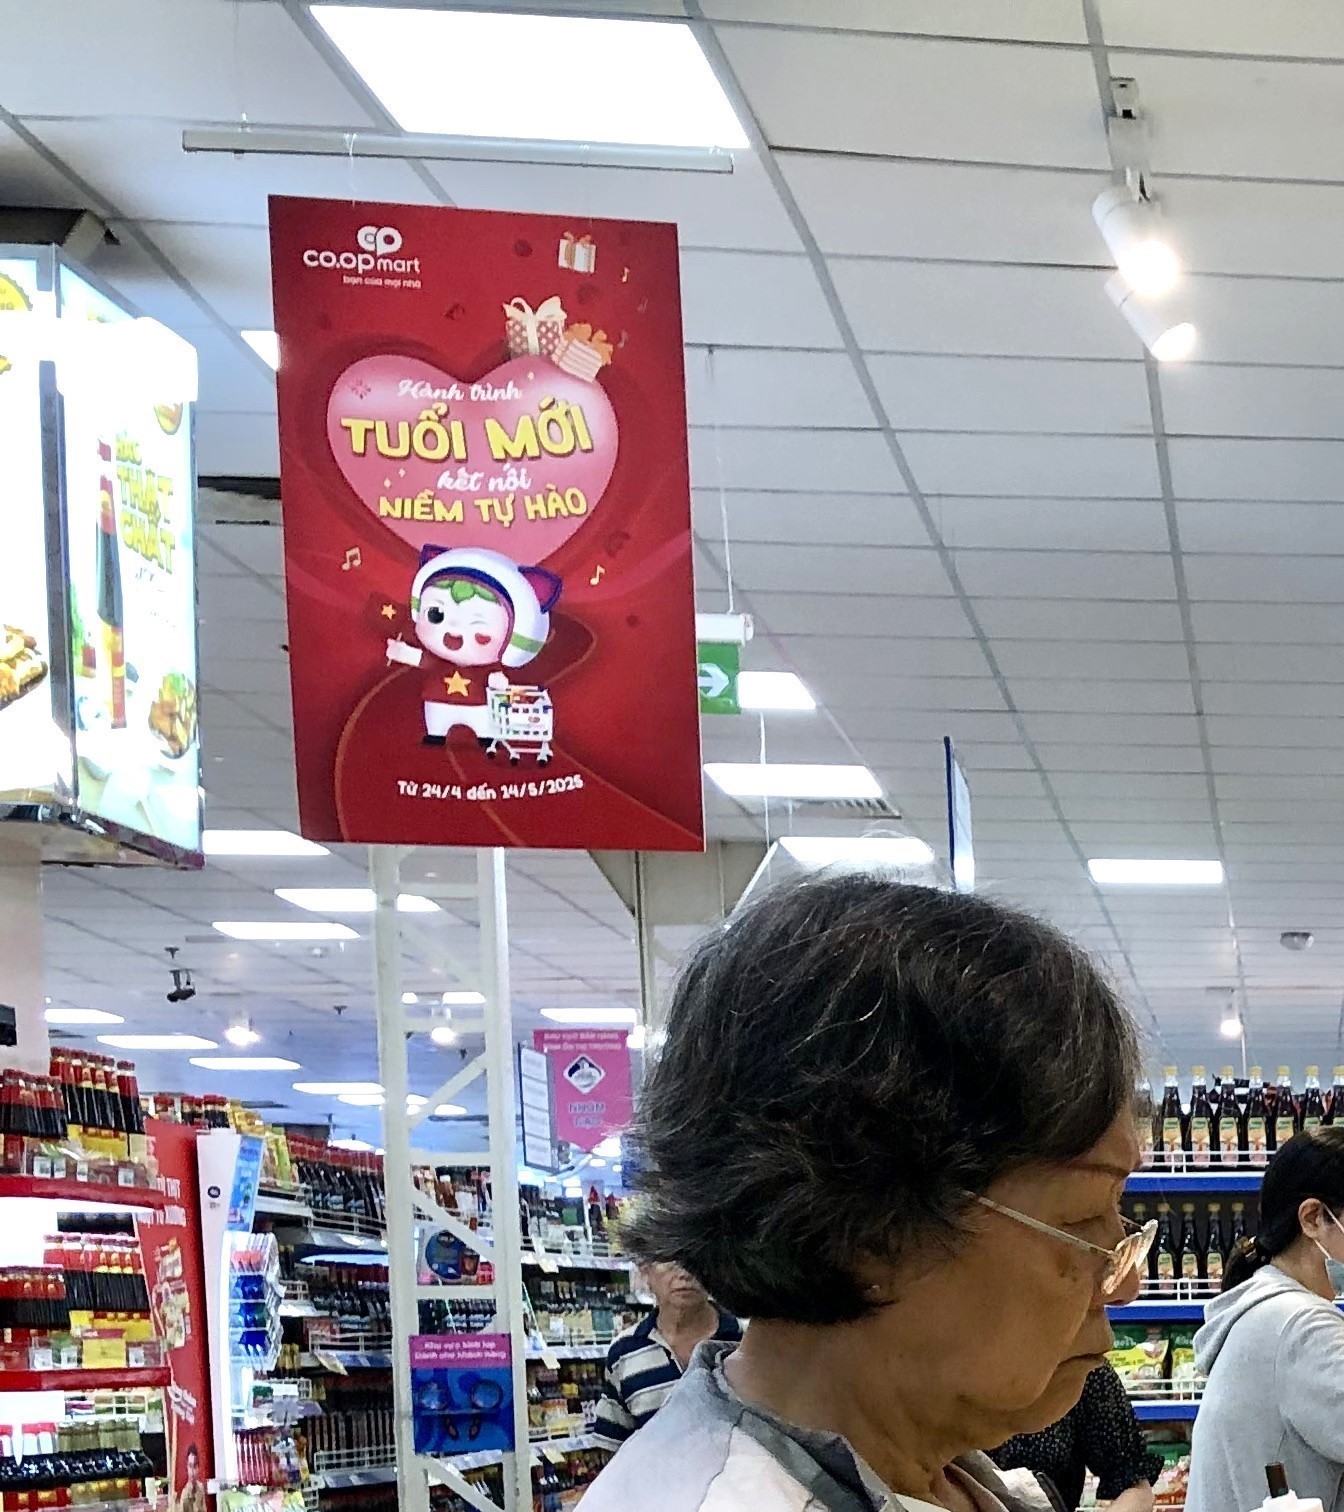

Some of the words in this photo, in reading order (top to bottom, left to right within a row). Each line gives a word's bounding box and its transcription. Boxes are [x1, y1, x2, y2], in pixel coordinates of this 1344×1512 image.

[340, 402, 469, 461] TUỔI
[484, 395, 594, 461] MỚI
[379, 488, 464, 522] NIỀM
[474, 492, 516, 528] TỰ
[524, 484, 588, 520] HÀO
